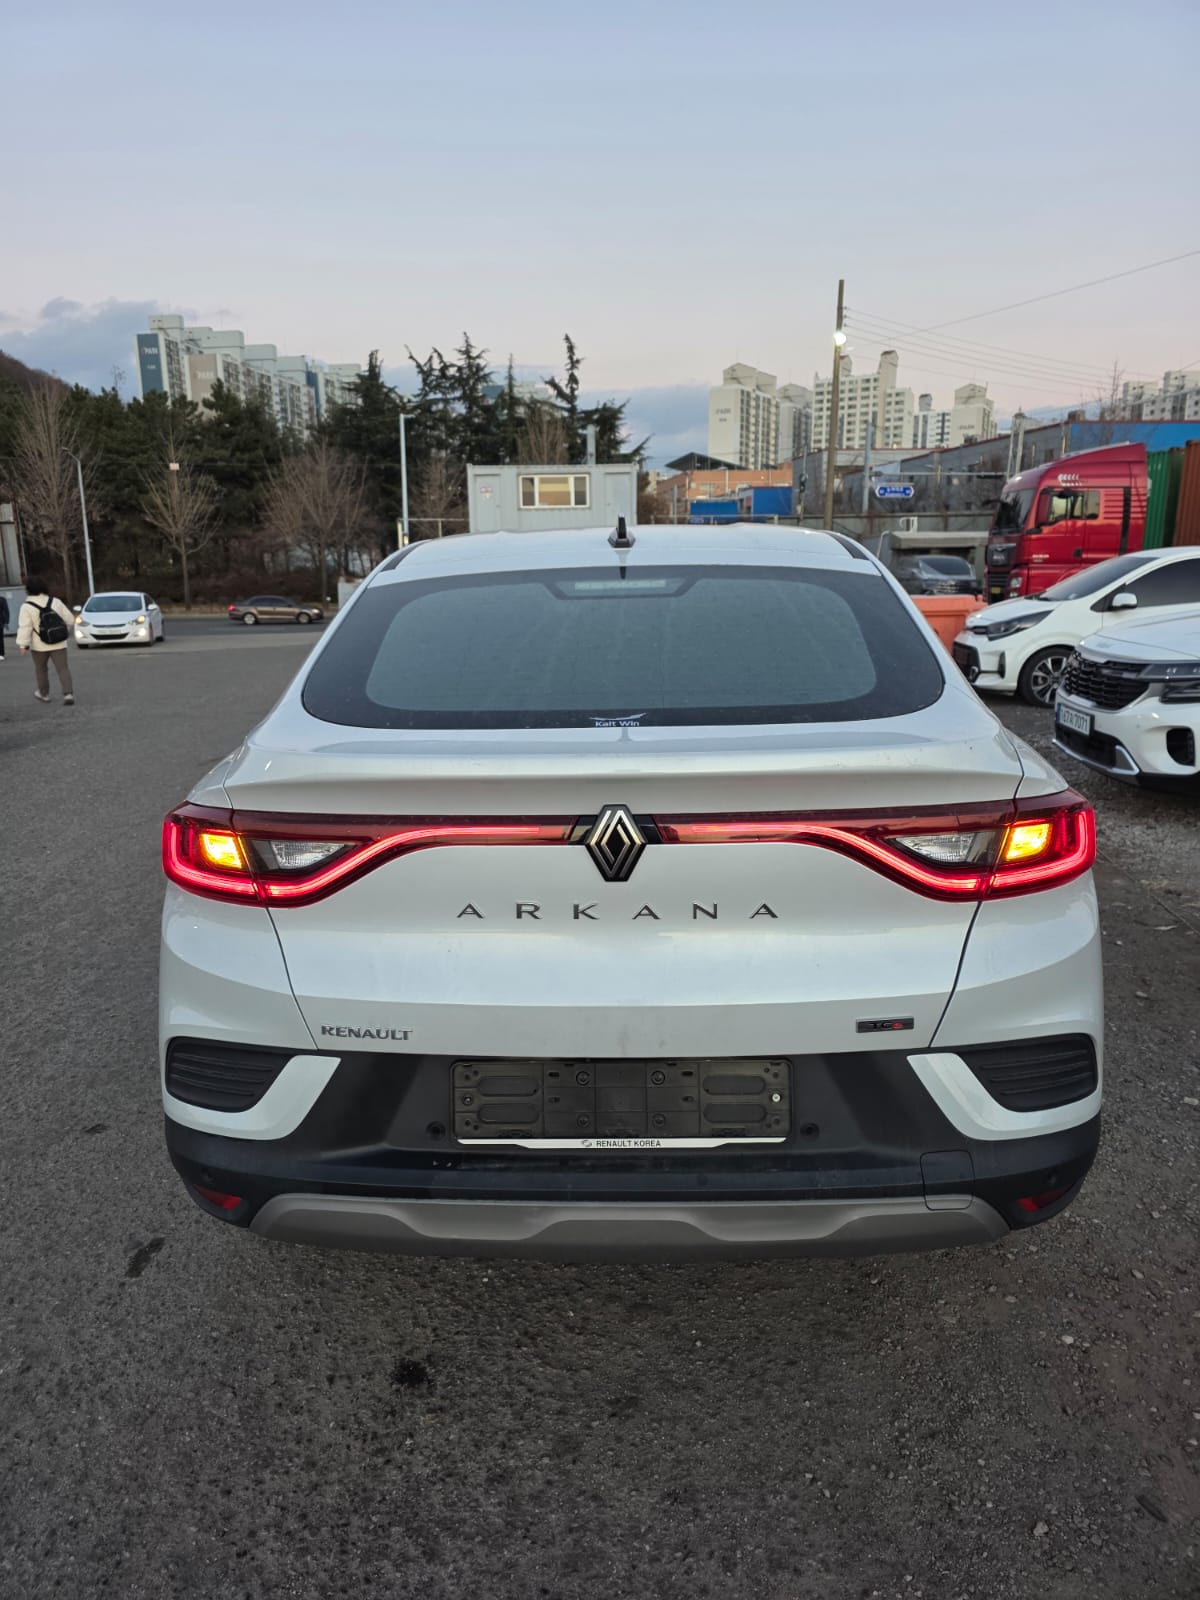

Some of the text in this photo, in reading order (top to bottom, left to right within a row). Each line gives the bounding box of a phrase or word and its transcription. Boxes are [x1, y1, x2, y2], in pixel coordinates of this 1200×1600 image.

[457, 903, 779, 920] ARKANA
[321, 1024, 413, 1041] RENAULT
[596, 1140, 662, 1148] RENAULT KOREA
